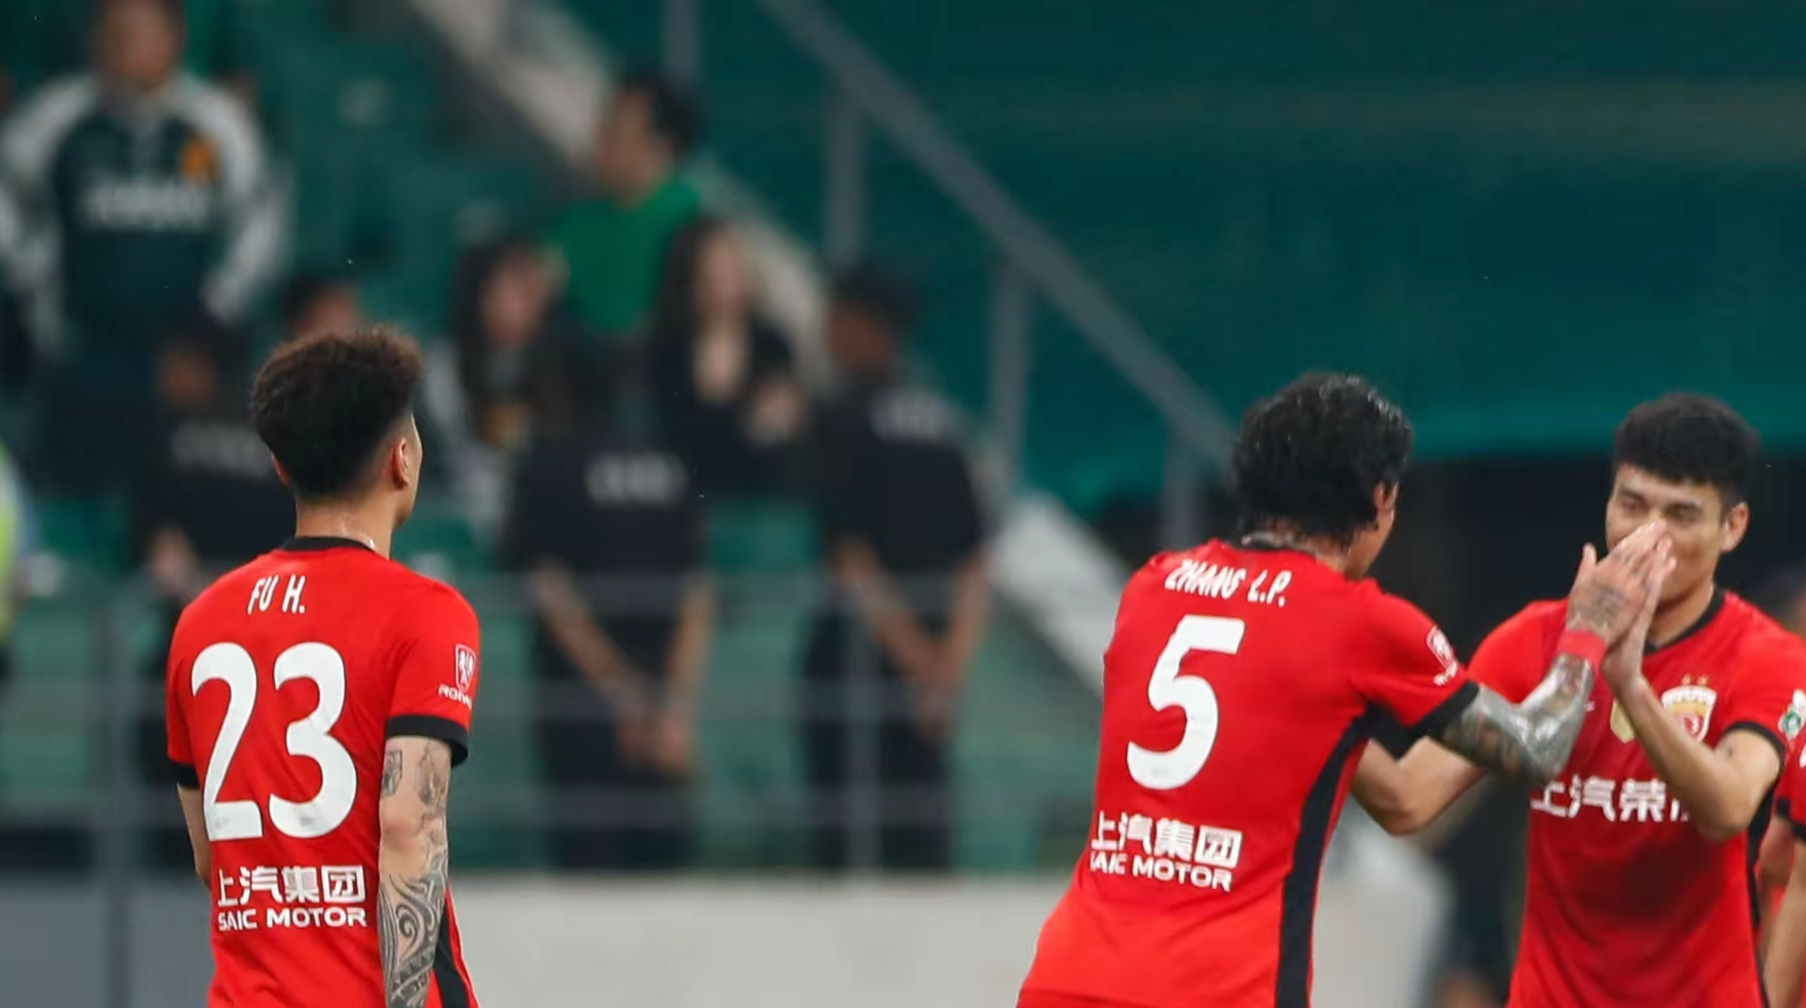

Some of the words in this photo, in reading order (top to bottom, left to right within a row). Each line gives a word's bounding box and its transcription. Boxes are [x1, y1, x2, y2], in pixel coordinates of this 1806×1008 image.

[247, 574, 278, 615] FU
[282, 575, 306, 615] H.
[1246, 569, 1293, 607] L.P.
[1127, 614, 1246, 791] 5
[190, 642, 358, 842] 23
[1530, 775, 1690, 823] 上汽荣
[1090, 810, 1244, 869] 上汽集团
[217, 865, 367, 907] 上汽集团
[1132, 854, 1233, 893] MOTOR
[217, 908, 258, 931] SAIC
[266, 906, 368, 928] MOTOR
